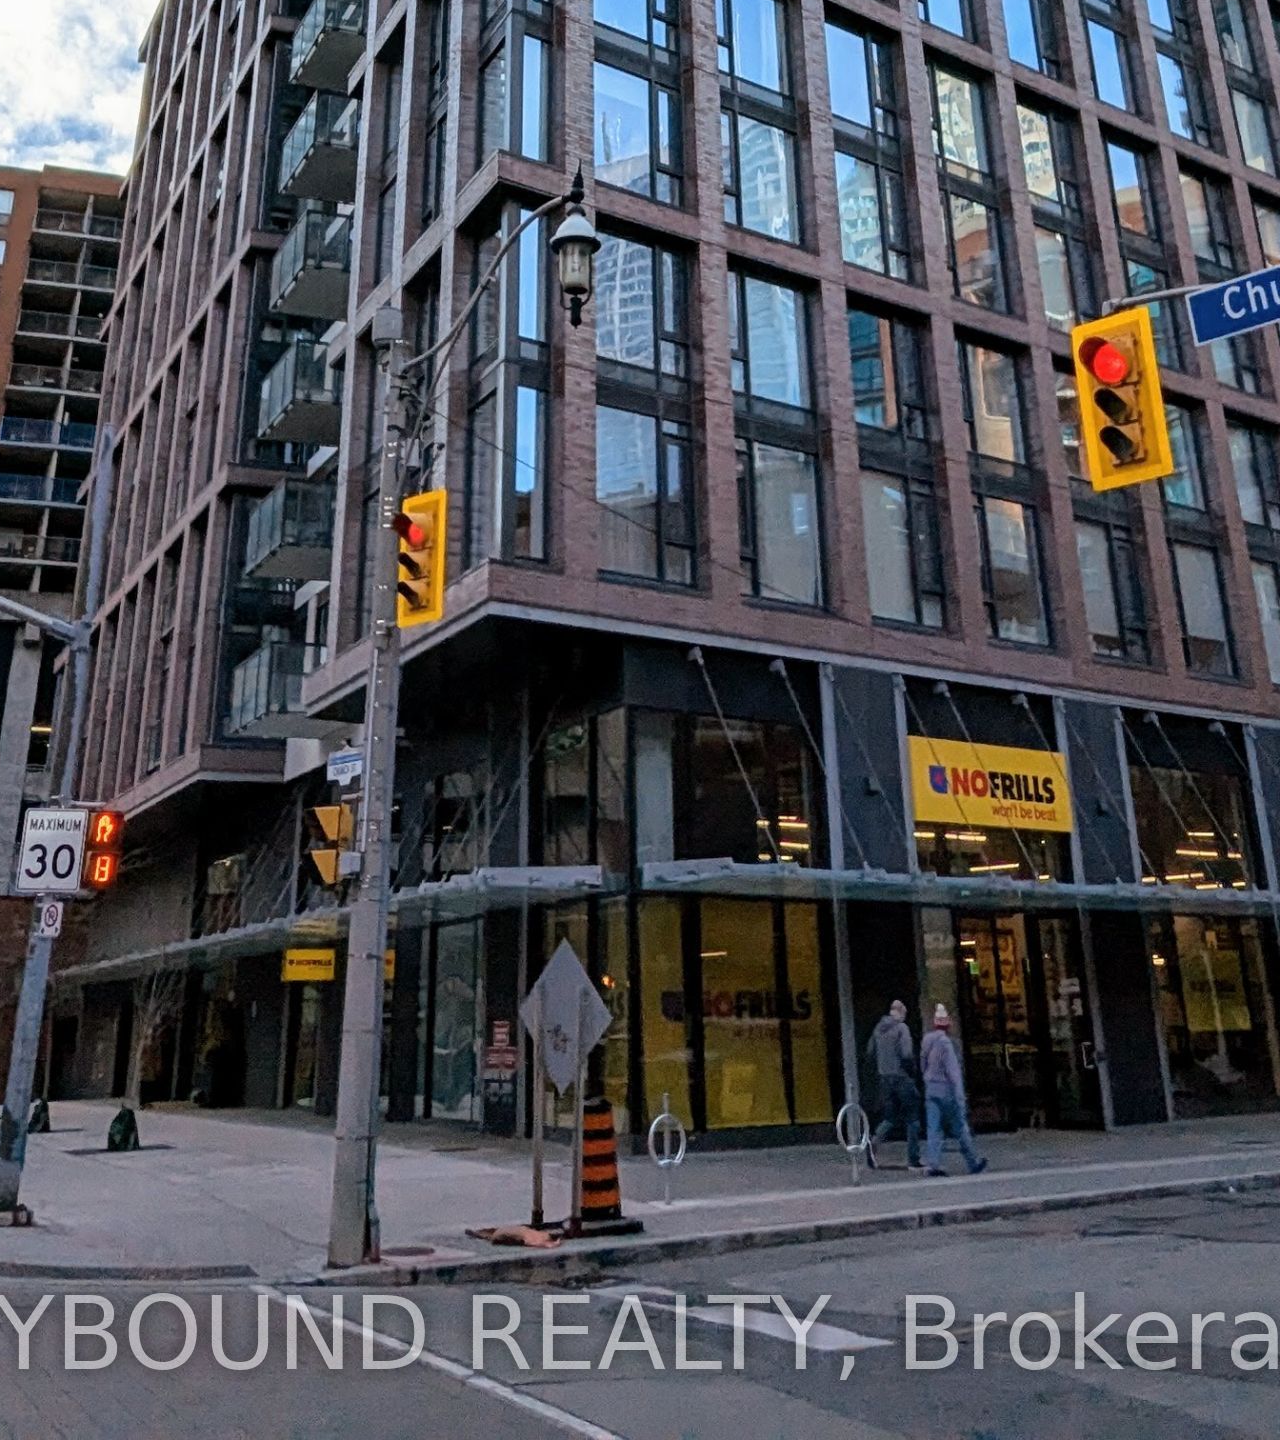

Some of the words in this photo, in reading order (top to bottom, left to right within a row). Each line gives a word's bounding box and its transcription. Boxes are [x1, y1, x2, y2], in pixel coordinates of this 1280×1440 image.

[991, 804, 1018, 820] won't
[1020, 806, 1033, 820] be
[1034, 807, 1057, 822] beat
[29, 818, 81, 832] MAXIMUM
[24, 843, 76, 879] 30
